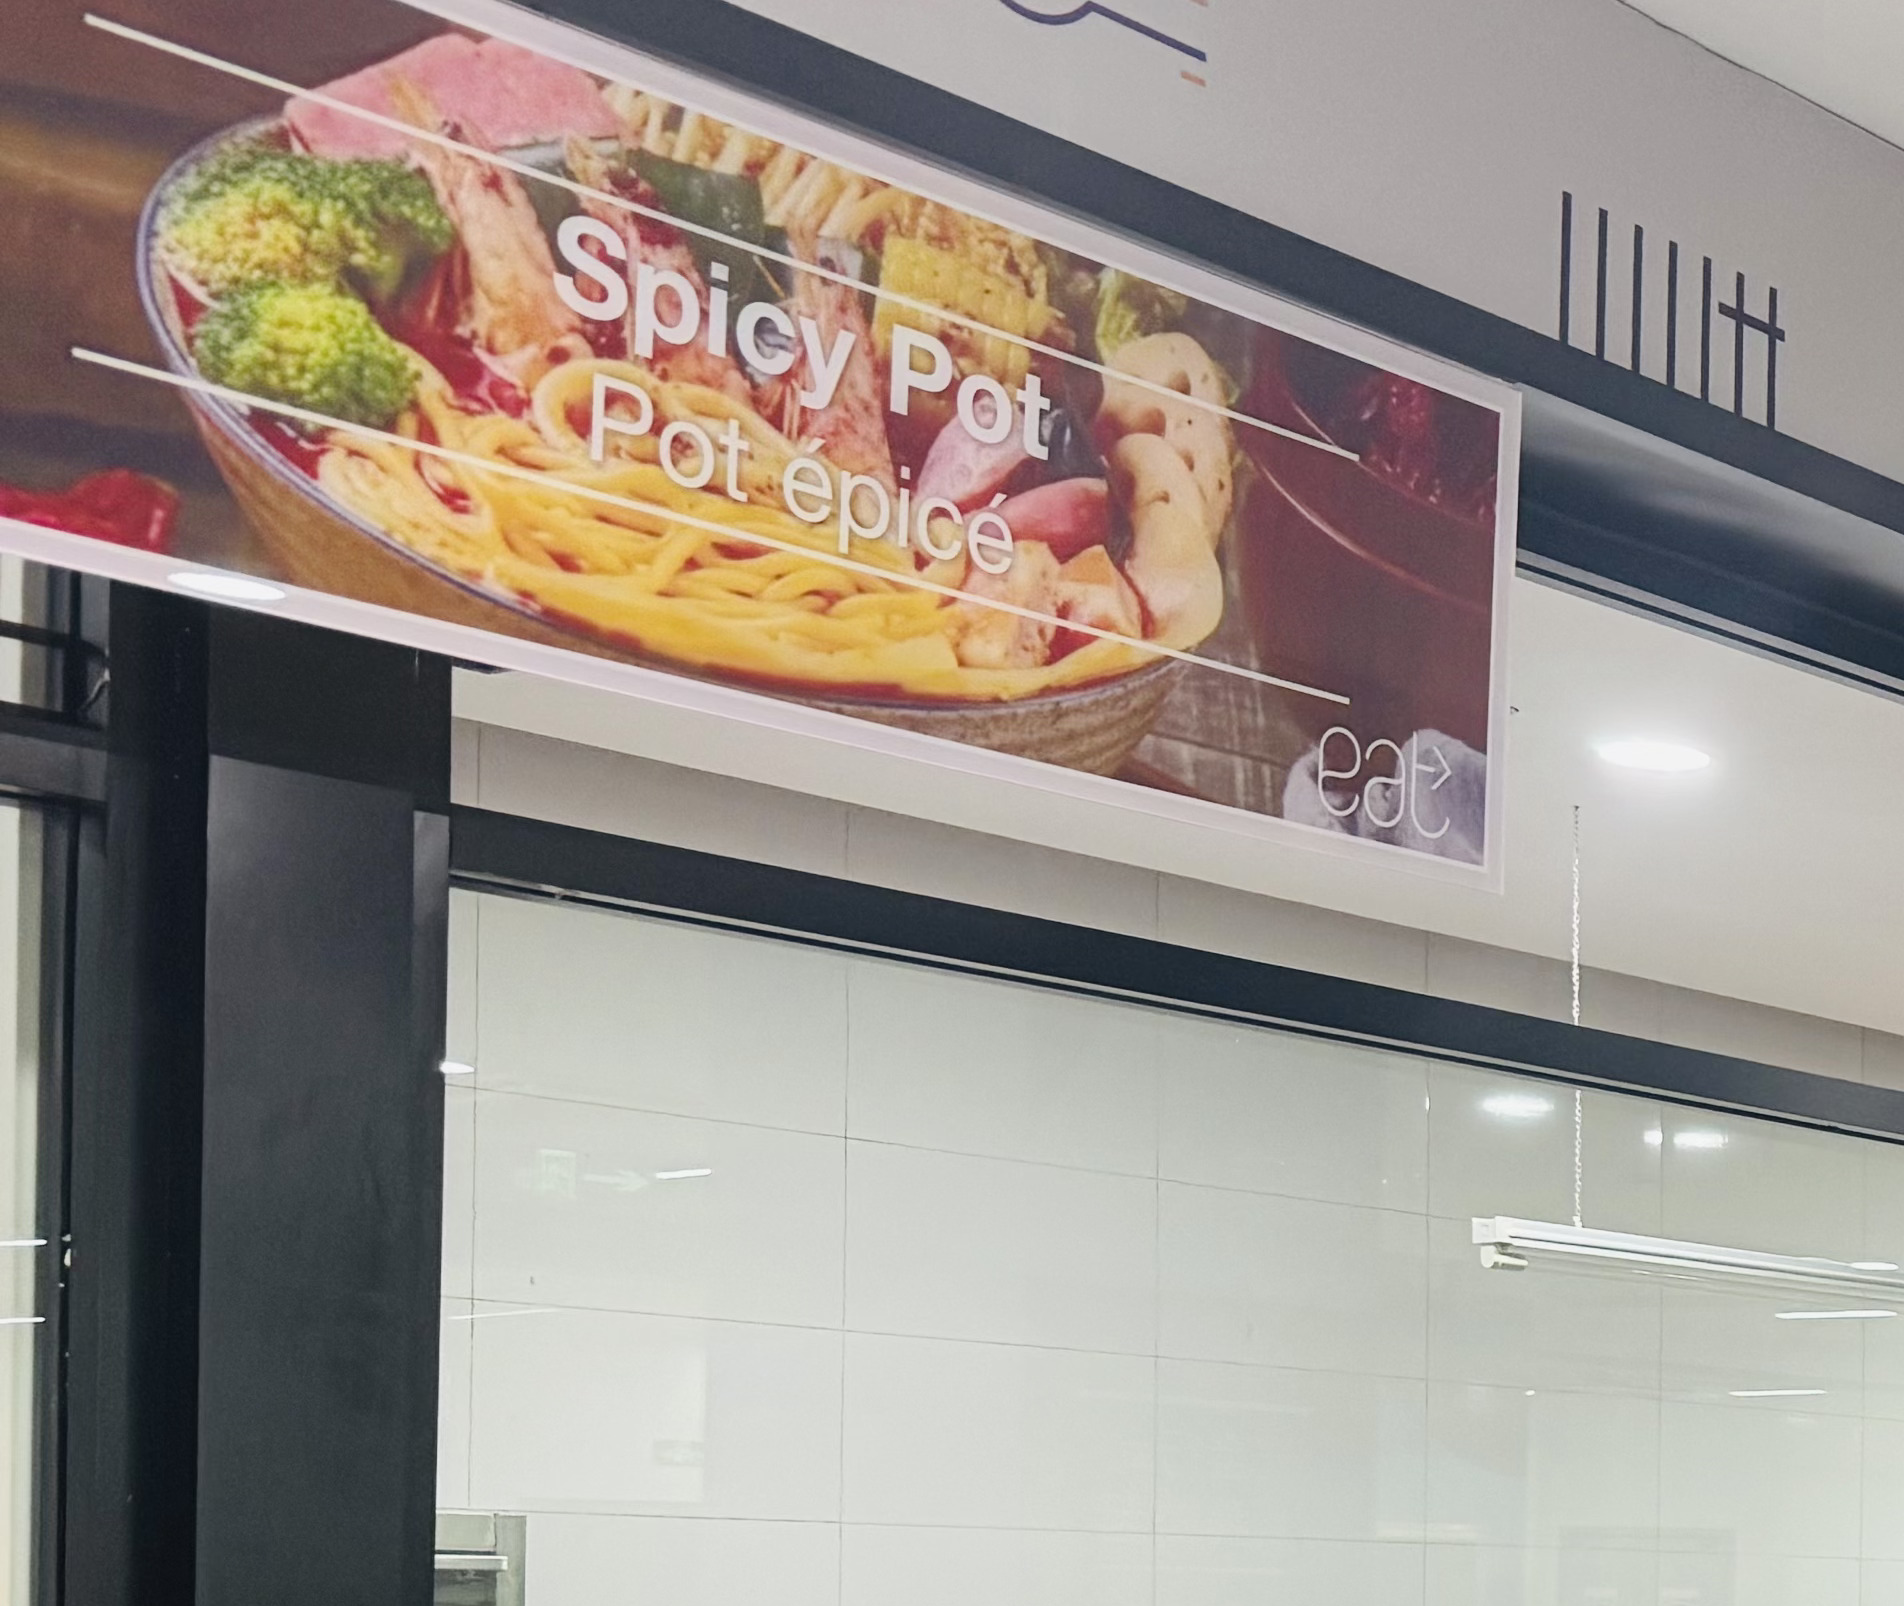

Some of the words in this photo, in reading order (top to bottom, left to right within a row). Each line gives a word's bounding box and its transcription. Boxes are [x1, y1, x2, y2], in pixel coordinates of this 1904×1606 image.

[553, 213, 858, 411] Spicy
[887, 325, 1054, 462] Pot
[587, 376, 751, 505] Pot
[783, 446, 1017, 577] épicé
[1317, 725, 1453, 841] eat
